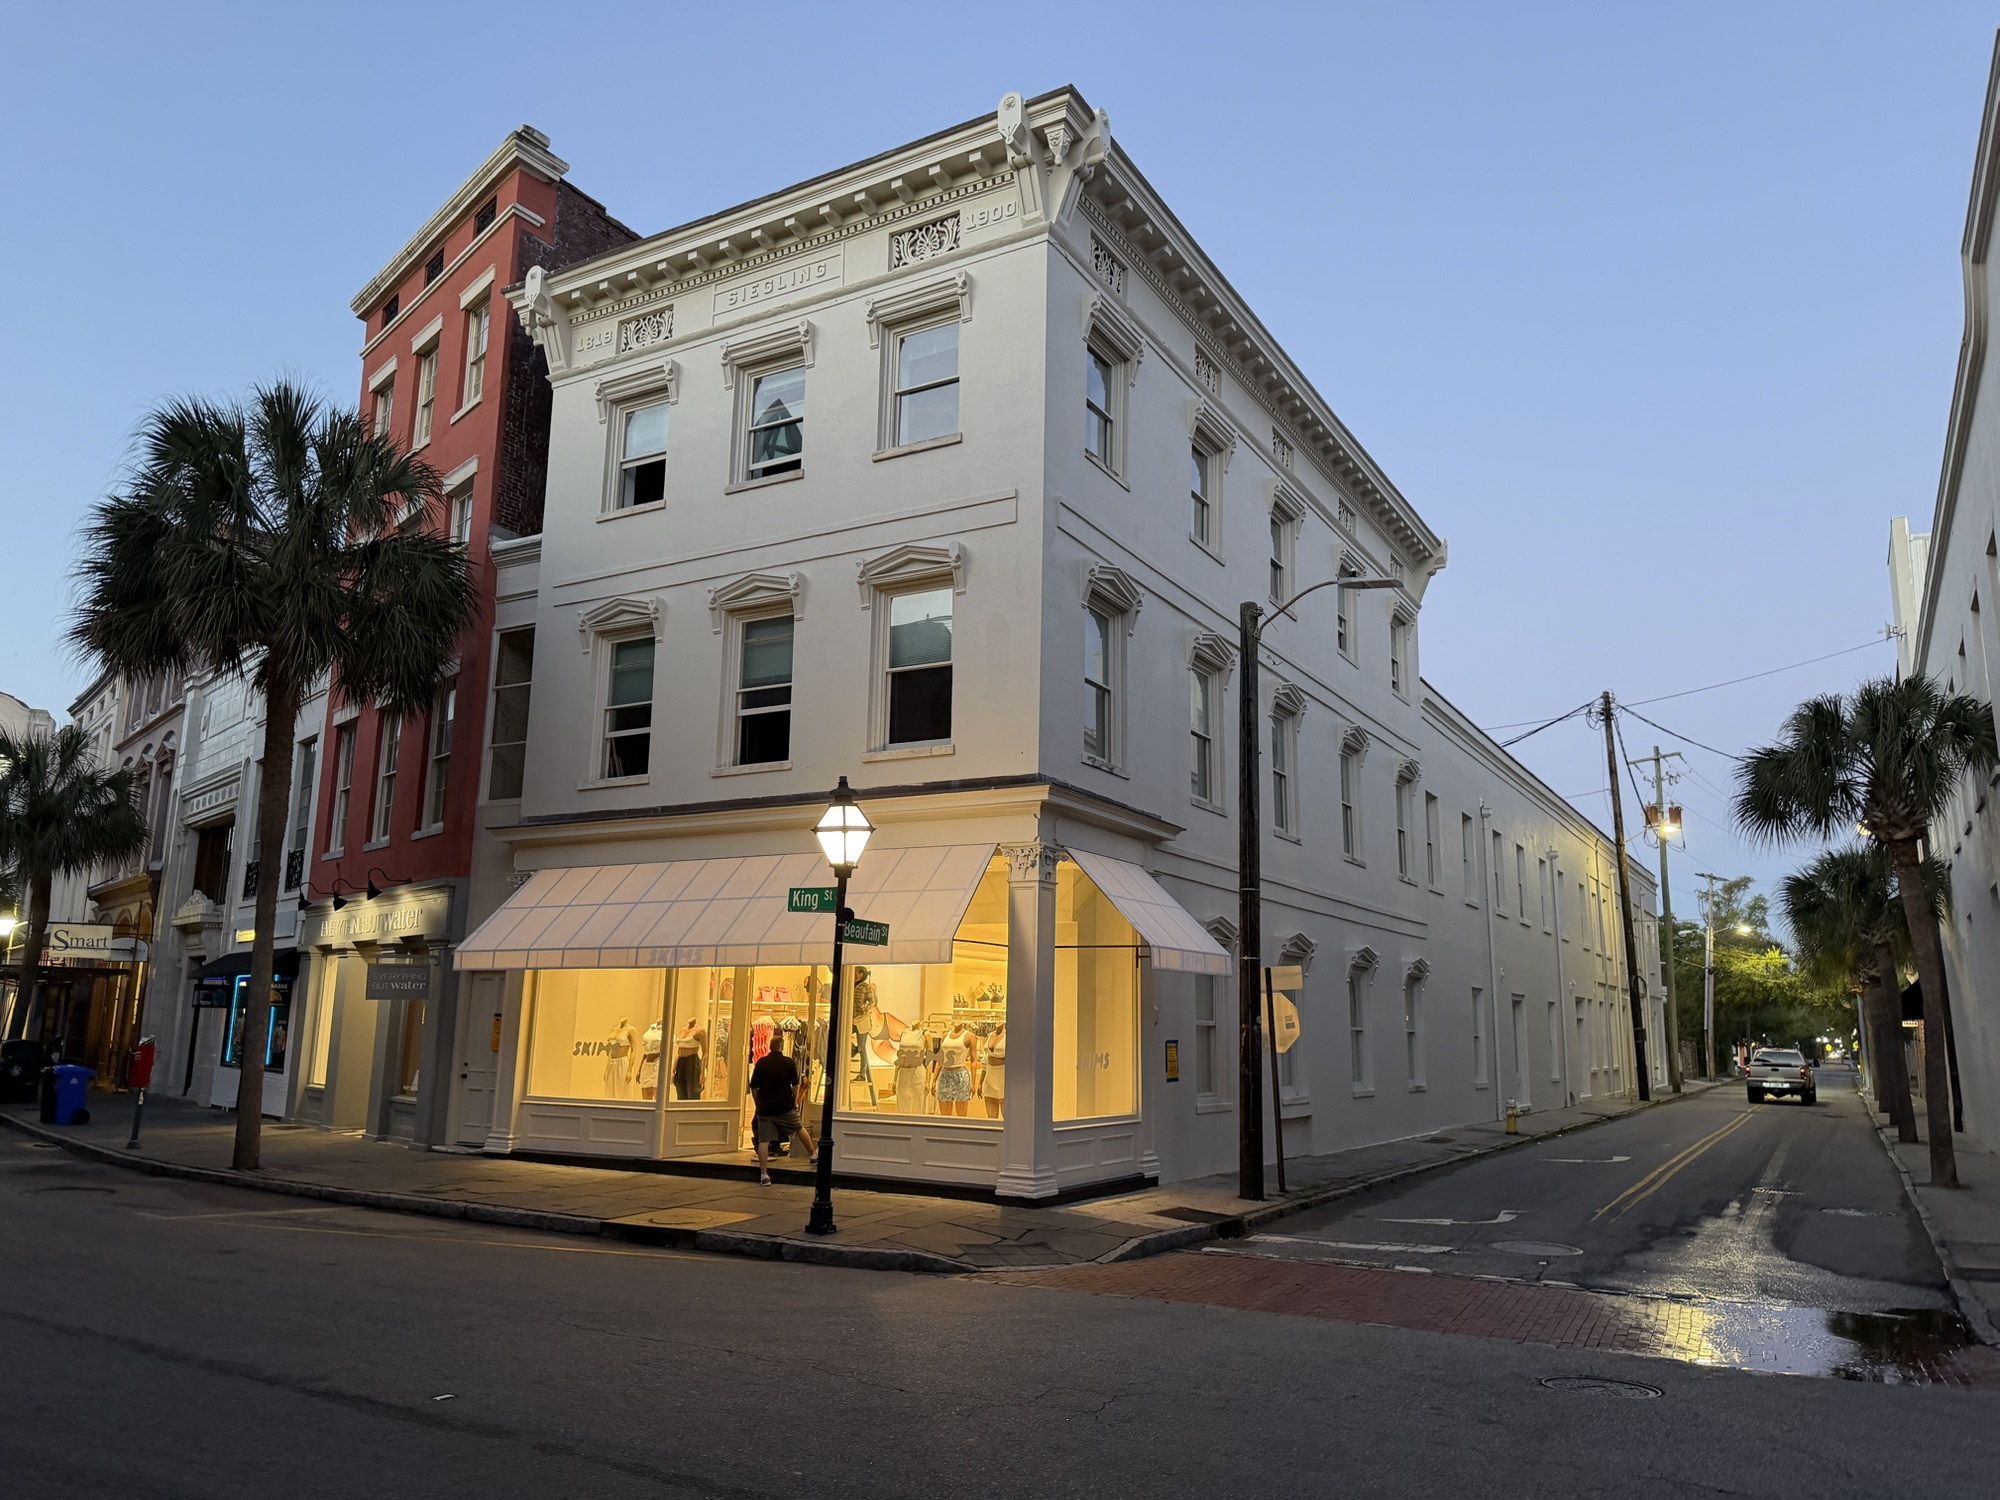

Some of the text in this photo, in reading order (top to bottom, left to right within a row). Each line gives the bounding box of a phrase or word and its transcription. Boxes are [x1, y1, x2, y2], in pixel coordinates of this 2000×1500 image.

[965, 201, 1017, 230] 1900
[728, 262, 827, 306] SIEGLING
[576, 330, 613, 352] 1819
[792, 889, 833, 910] King St
[384, 906, 422, 932] water
[53, 929, 108, 952] Smart
[844, 921, 888, 941] Beaufain St
[647, 948, 704, 965] SKIMS
[372, 972, 427, 981] EVERYTHING
[372, 981, 426, 990] BUT water
